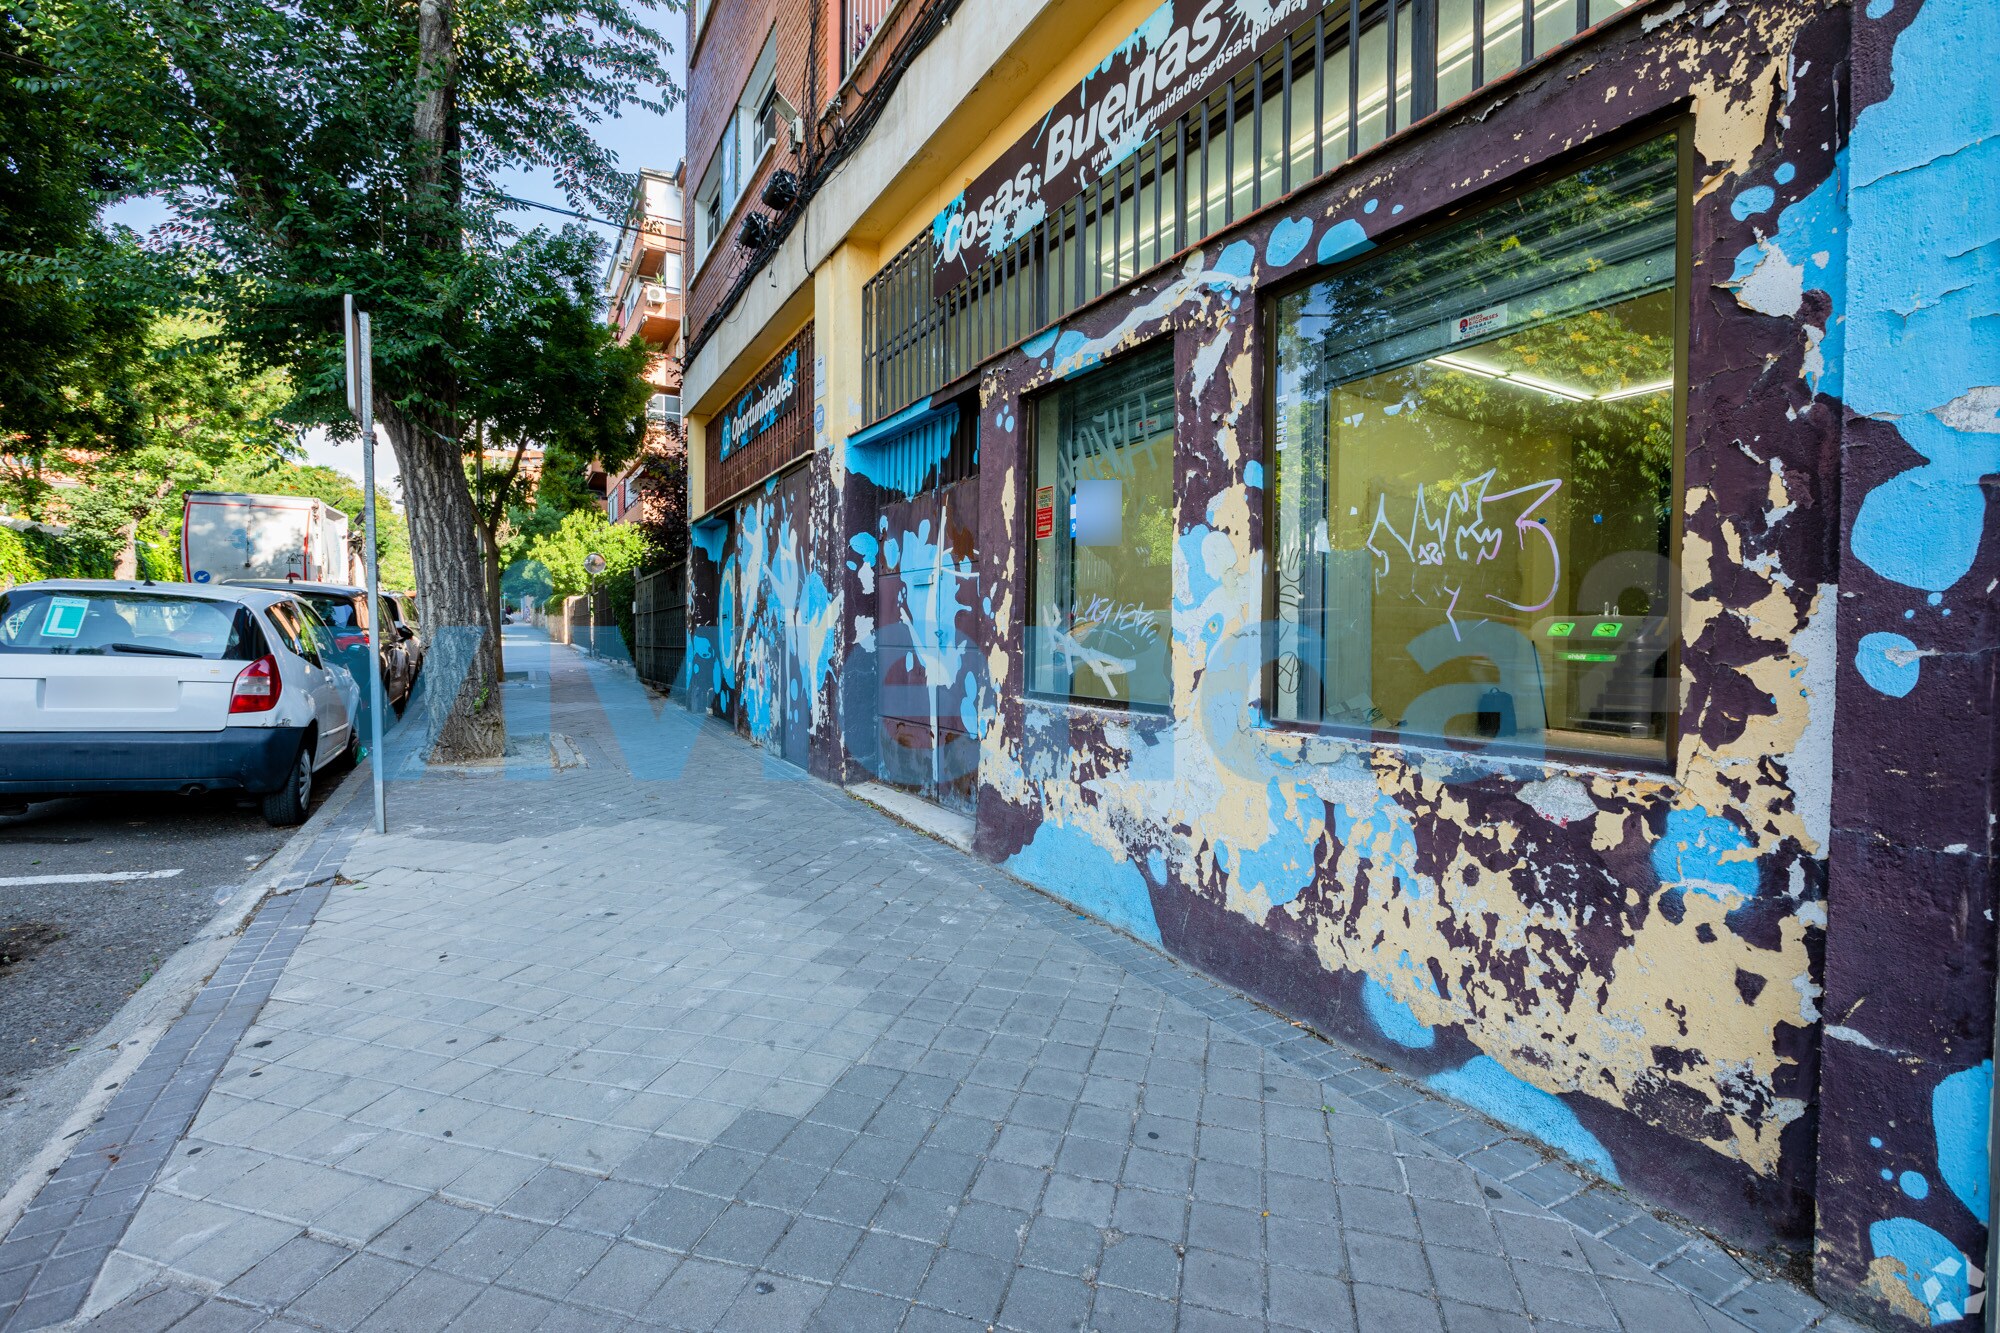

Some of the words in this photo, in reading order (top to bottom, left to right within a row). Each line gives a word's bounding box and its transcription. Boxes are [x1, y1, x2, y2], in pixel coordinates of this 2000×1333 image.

[943, 162, 1033, 263] Cosas
[1044, 0, 1224, 186] Buenas
[731, 373, 793, 444] Oportunidades
[46, 607, 76, 635] L
